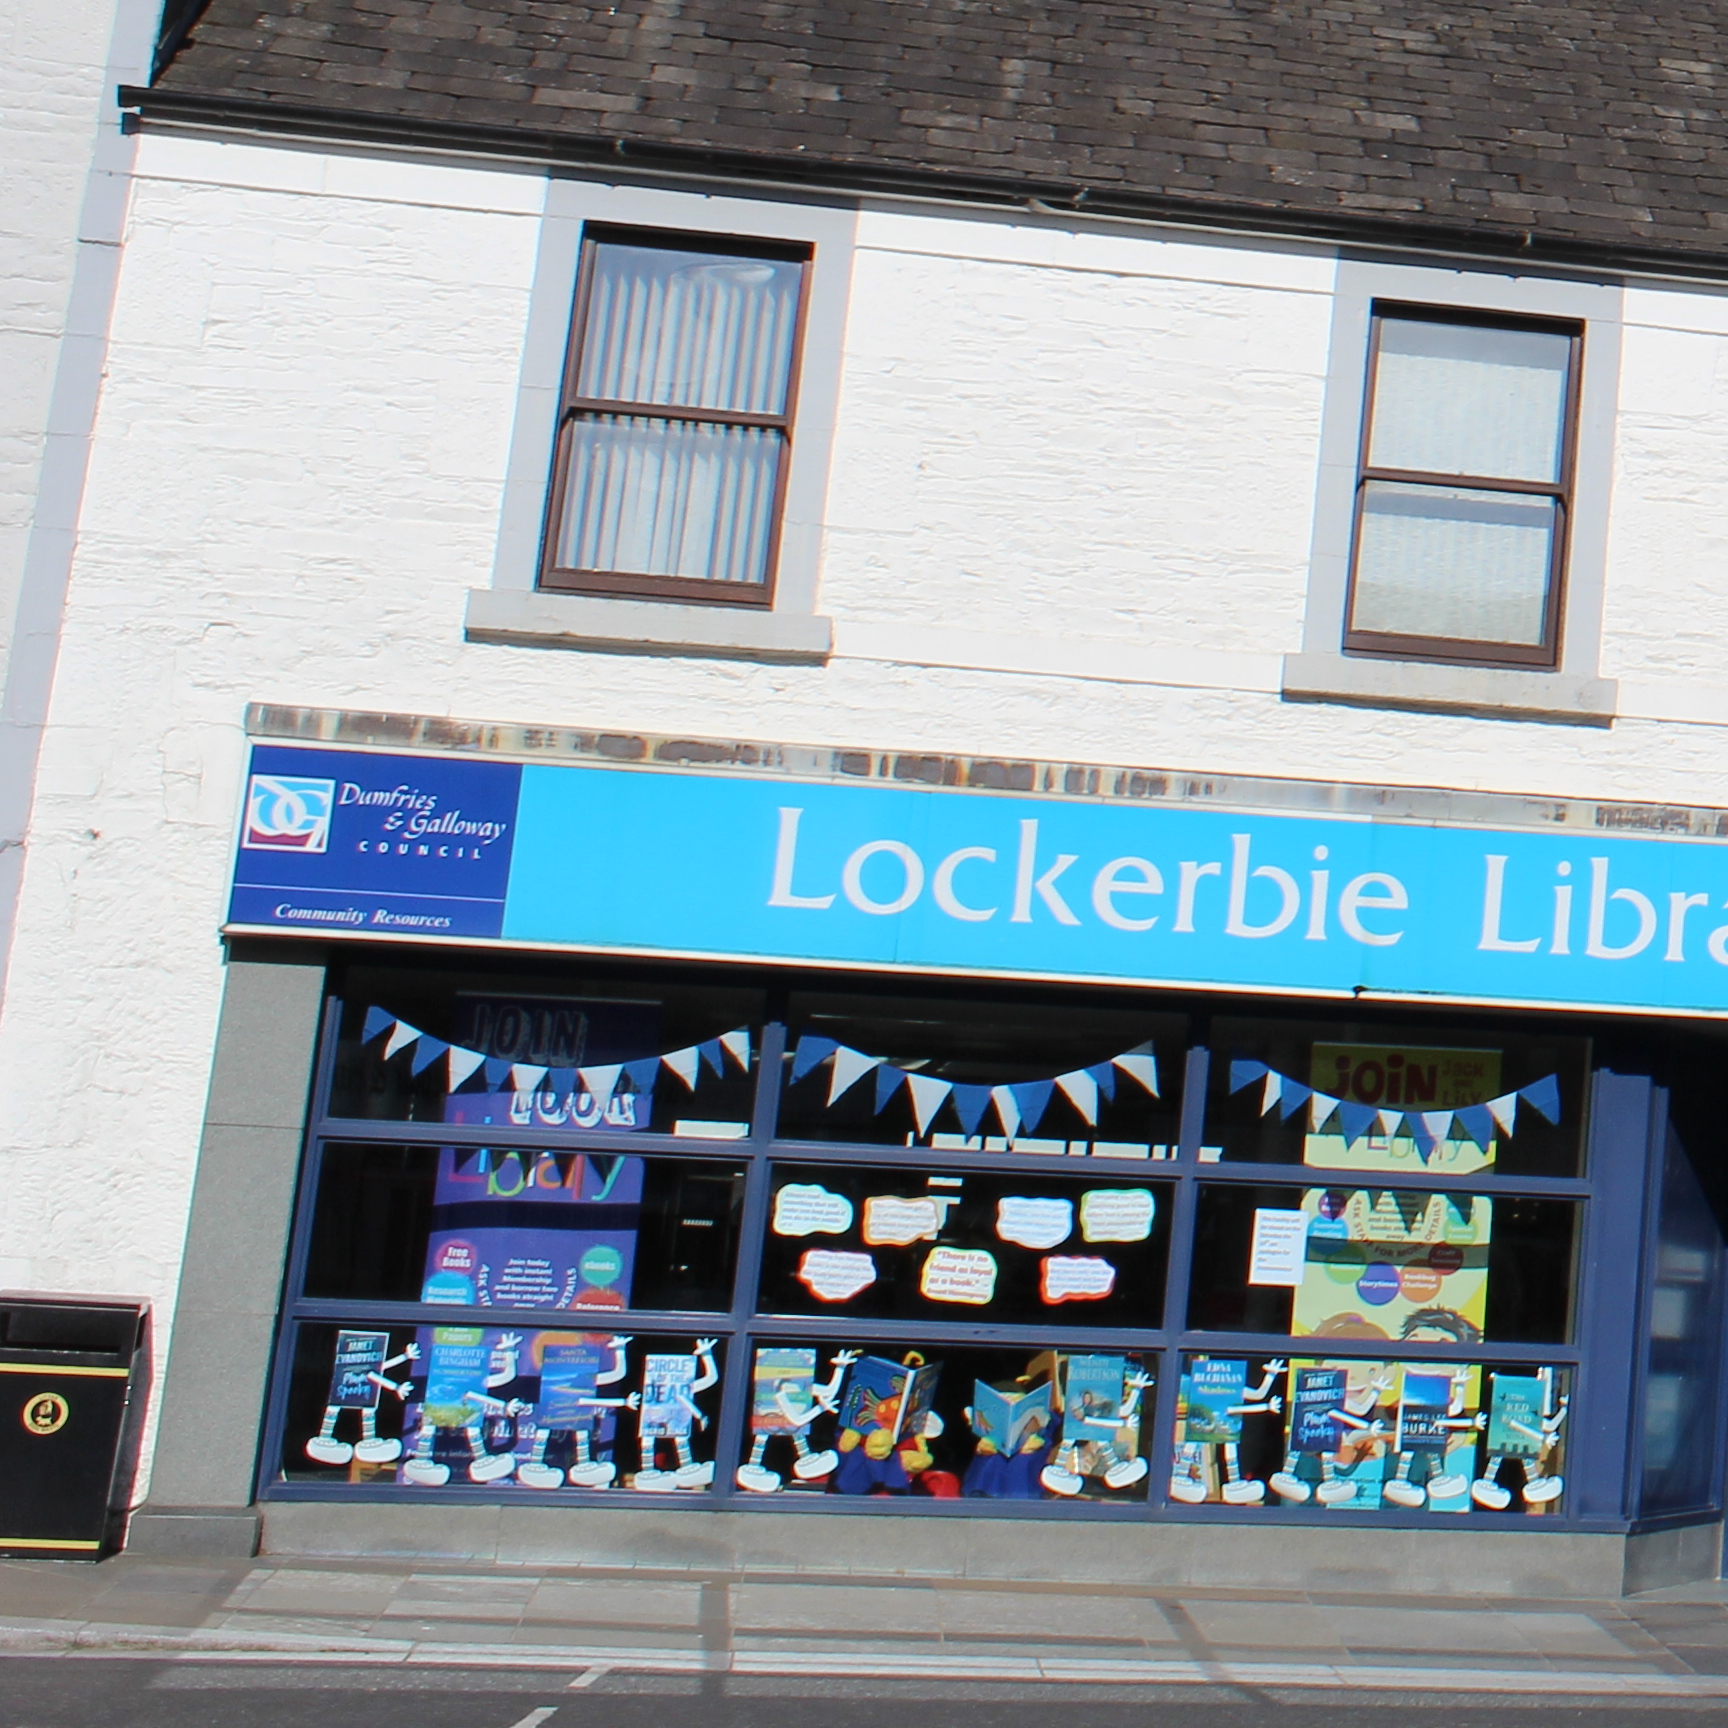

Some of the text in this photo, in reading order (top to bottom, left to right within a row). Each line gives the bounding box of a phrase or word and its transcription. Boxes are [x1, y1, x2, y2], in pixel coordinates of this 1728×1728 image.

[339, 782, 438, 811] Dumfries
[383, 810, 507, 845] & Galloway
[359, 840, 482, 860] COUNCIL
[766, 806, 1410, 947] Lockerbie
[274, 903, 452, 928] Community Resources
[447, 1245, 469, 1257] Free
[442, 1256, 472, 1268] Books
[347, 1340, 374, 1352] JANET
[336, 1351, 383, 1365] EVANOVICH
[435, 1348, 486, 1359] CHARLOTTE
[438, 1357, 482, 1367] BINGHAM
[646, 1358, 692, 1373] CIRCLE
[1206, 1361, 1231, 1372] EDNA
[1193, 1373, 1243, 1383] BUCHANAN
[1306, 1374, 1335, 1389] JANET
[1296, 1387, 1344, 1403] EVANOVICH
[1506, 1403, 1530, 1412] RED
[1403, 1412, 1430, 1422] JAMES
